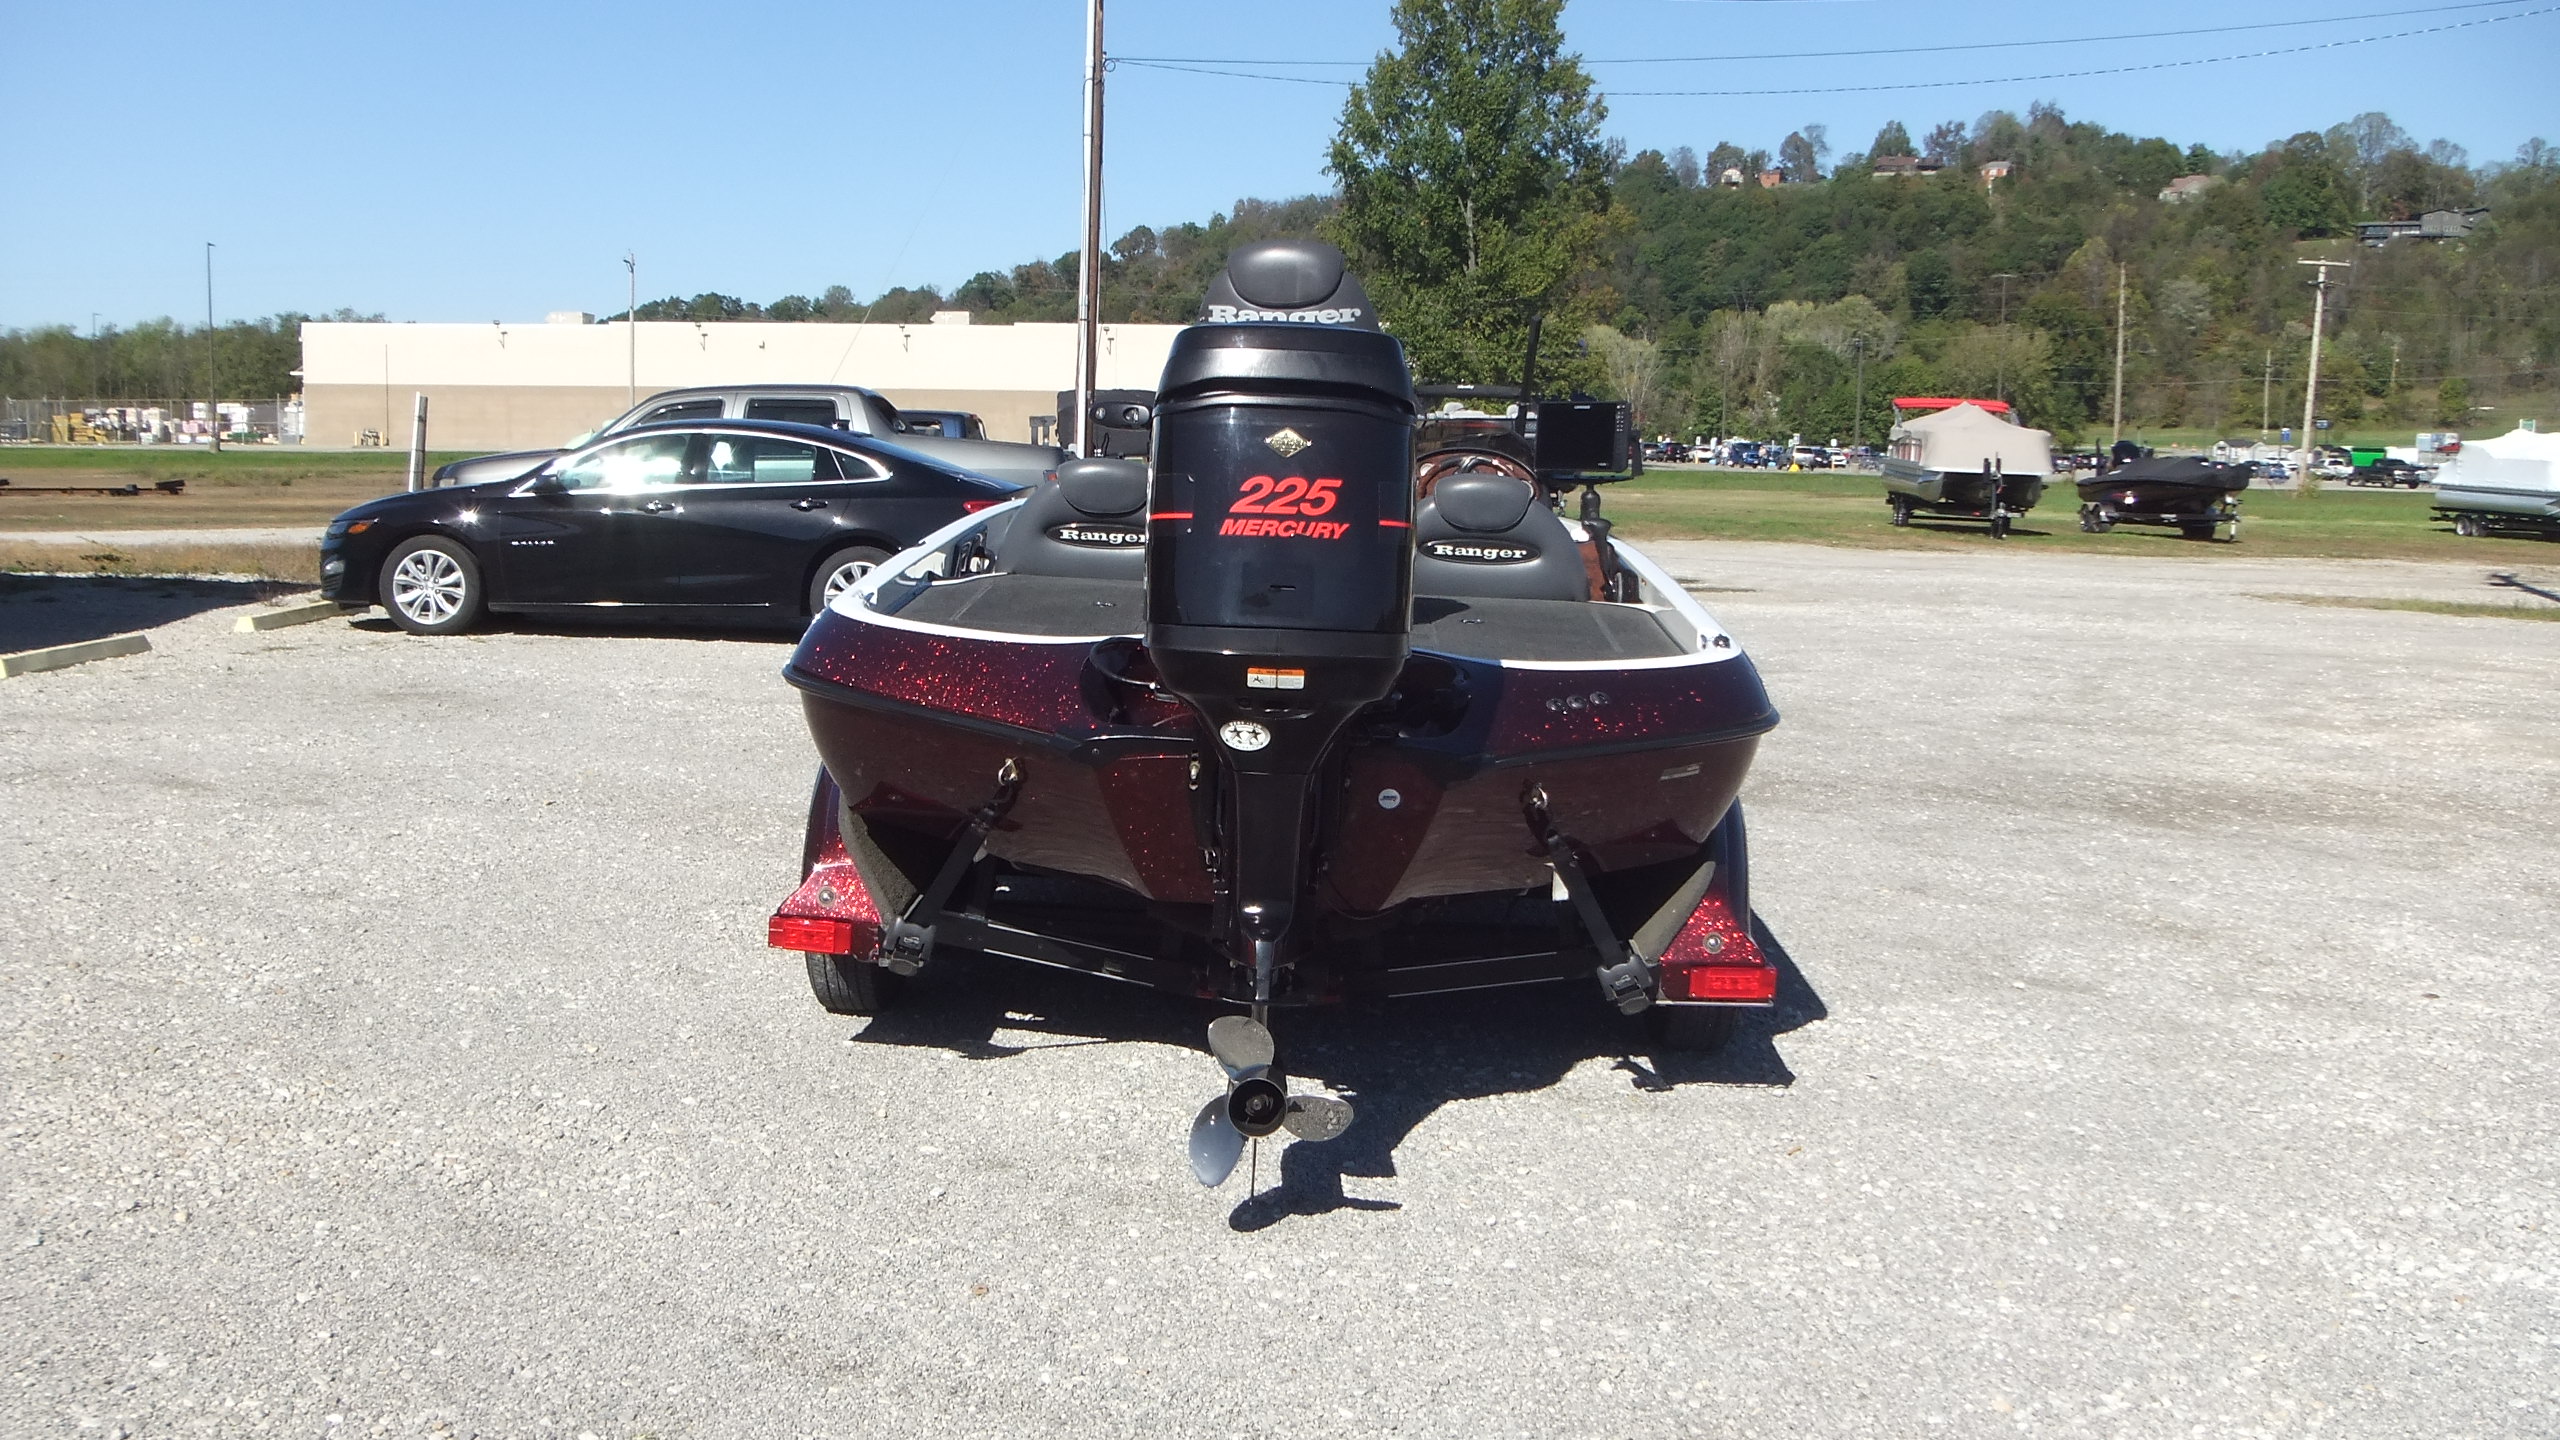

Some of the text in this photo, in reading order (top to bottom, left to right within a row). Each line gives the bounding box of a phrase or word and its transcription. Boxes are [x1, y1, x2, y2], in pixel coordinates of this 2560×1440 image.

[1229, 475, 1343, 516] 225
[1219, 518, 1350, 539] MERCURY
[1434, 545, 1527, 559] Ranger
